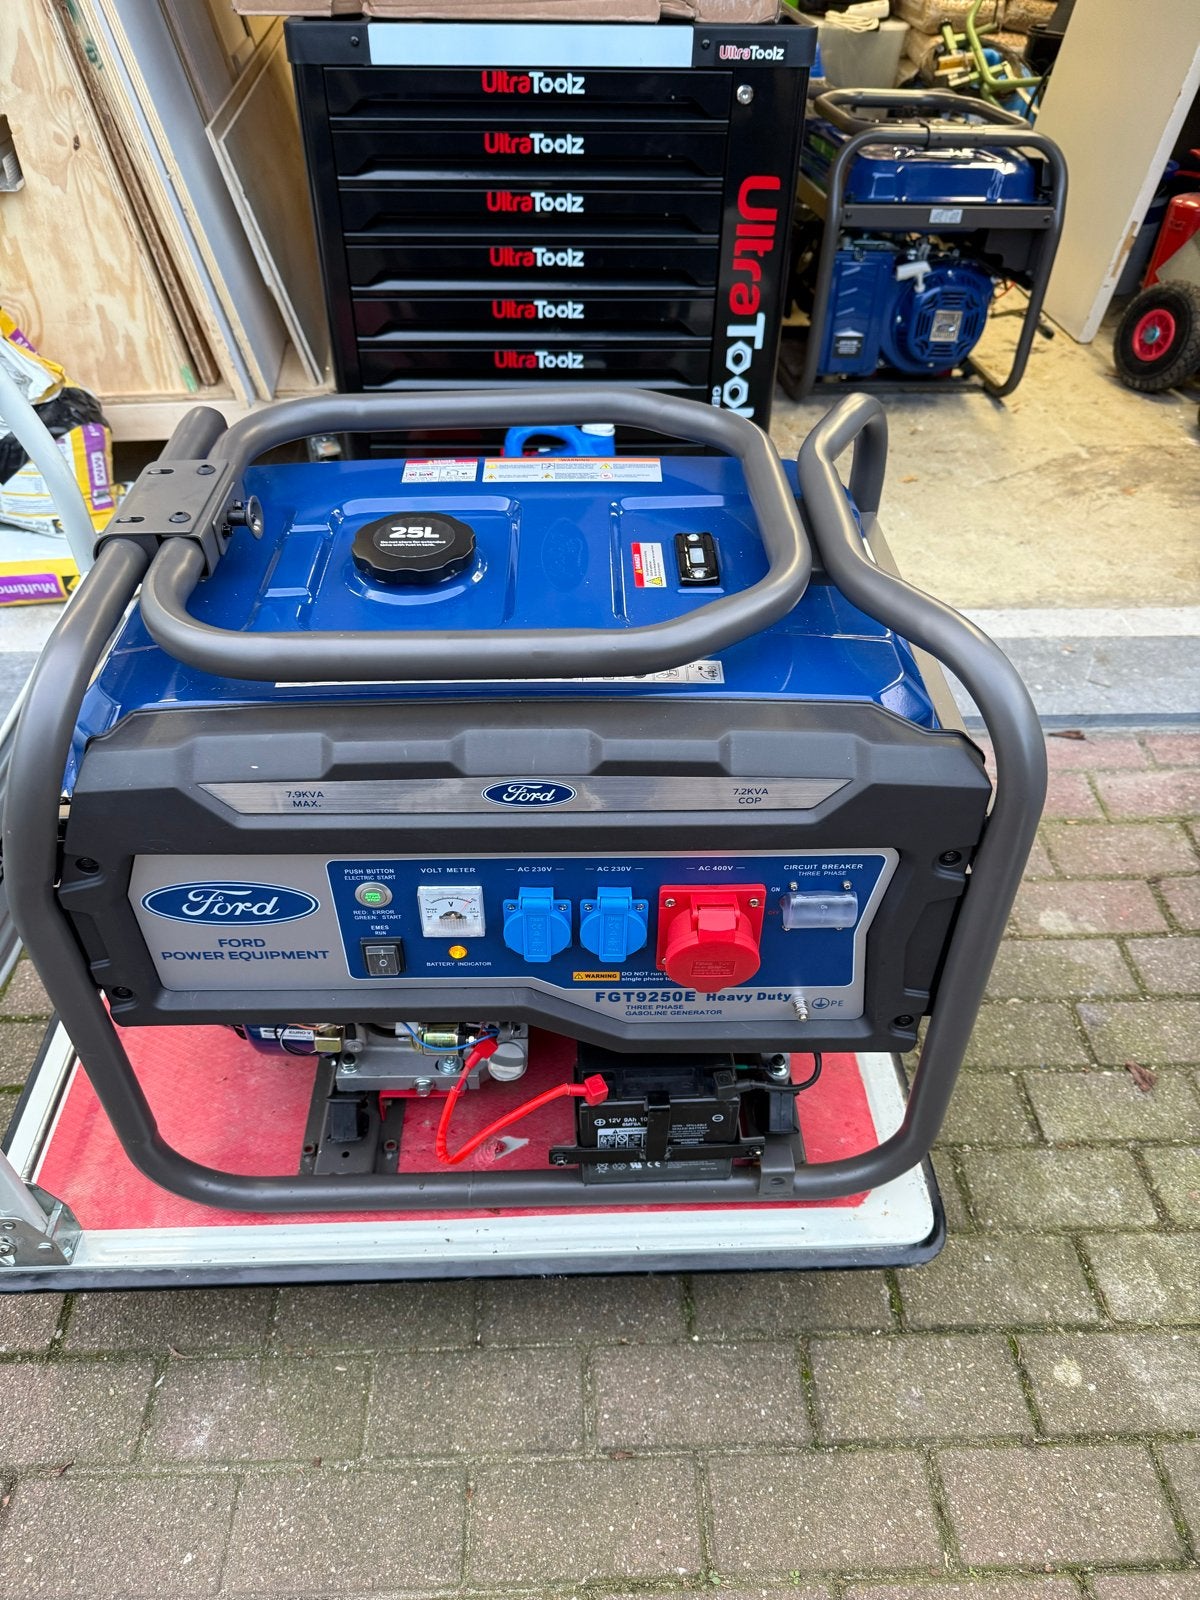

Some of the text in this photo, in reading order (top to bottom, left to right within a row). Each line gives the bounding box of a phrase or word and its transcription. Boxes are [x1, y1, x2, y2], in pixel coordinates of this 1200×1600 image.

[719, 44, 785, 61] UltraToolz
[481, 70, 586, 95] UltraToolz
[483, 132, 585, 155] UltraToolz
[486, 190, 585, 213] UltraToolz
[489, 246, 585, 267] UltraToolz
[491, 299, 585, 319] UltraToolz
[494, 350, 585, 369] UltraToolz
[389, 526, 440, 539] 25L
[285, 790, 325, 798] 7.9KVA
[502, 784, 556, 802] Ford
[733, 788, 769, 796] 7.2KVA
[292, 800, 322, 808] MAX.
[181, 888, 280, 917] Ford
[217, 938, 266, 948] FORD
[161, 950, 330, 962] POWER EQUIPMENT
[595, 991, 792, 1003] FGT9250E Heavy Duty
